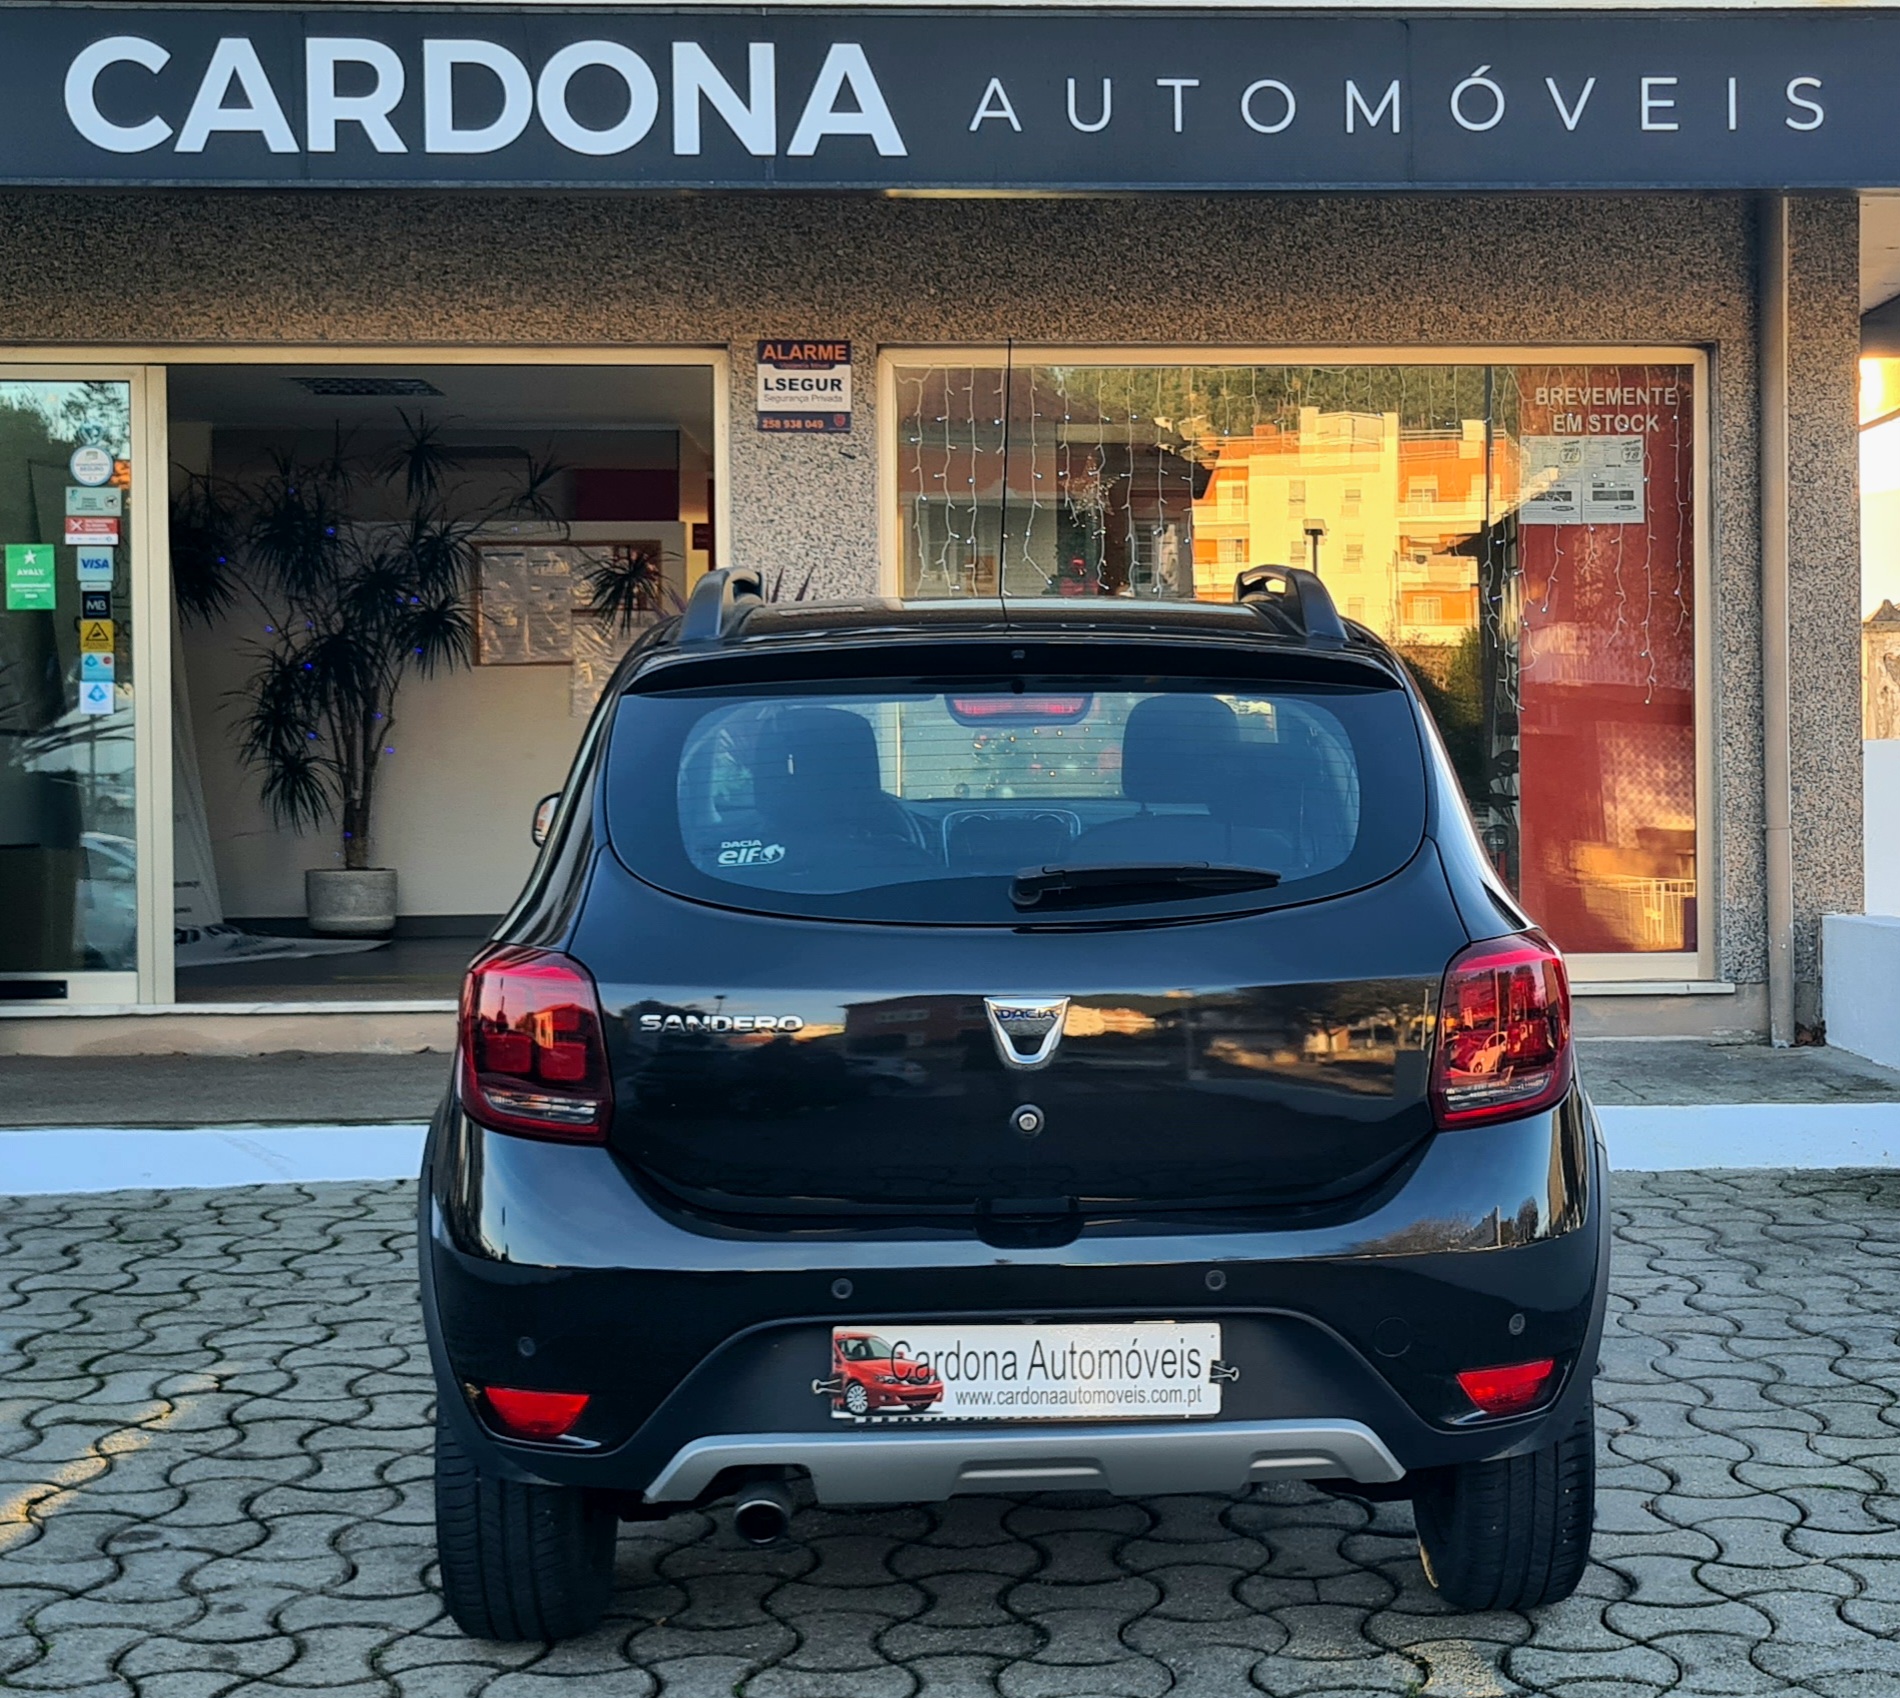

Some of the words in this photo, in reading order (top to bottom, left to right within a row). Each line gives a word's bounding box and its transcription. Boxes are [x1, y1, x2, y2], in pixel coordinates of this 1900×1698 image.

[64, 36, 908, 156] CARDONA
[968, 65, 1826, 134] AUTOMÓVEIS
[762, 344, 847, 360] ALARME
[764, 378, 843, 391] LSEGUR
[764, 393, 809, 403] Segurança
[811, 394, 843, 403] Privada
[1535, 387, 1678, 406] BREVEMENTE
[804, 420, 824, 429] 049
[1552, 414, 1582, 433] EM
[1588, 414, 1660, 433] STOCK
[81, 559, 109, 569] VISA
[86, 600, 107, 611] MB
[720, 840, 762, 849] DACIA
[717, 847, 762, 865] elf
[999, 1009, 1056, 1020] DACIA
[640, 1014, 805, 1033] SANDERO
[890, 1339, 1018, 1382] Cardona
[1026, 1337, 1202, 1380] Automóveis
[954, 1385, 1202, 1408] www.cardonaautomoveis.com.pt
